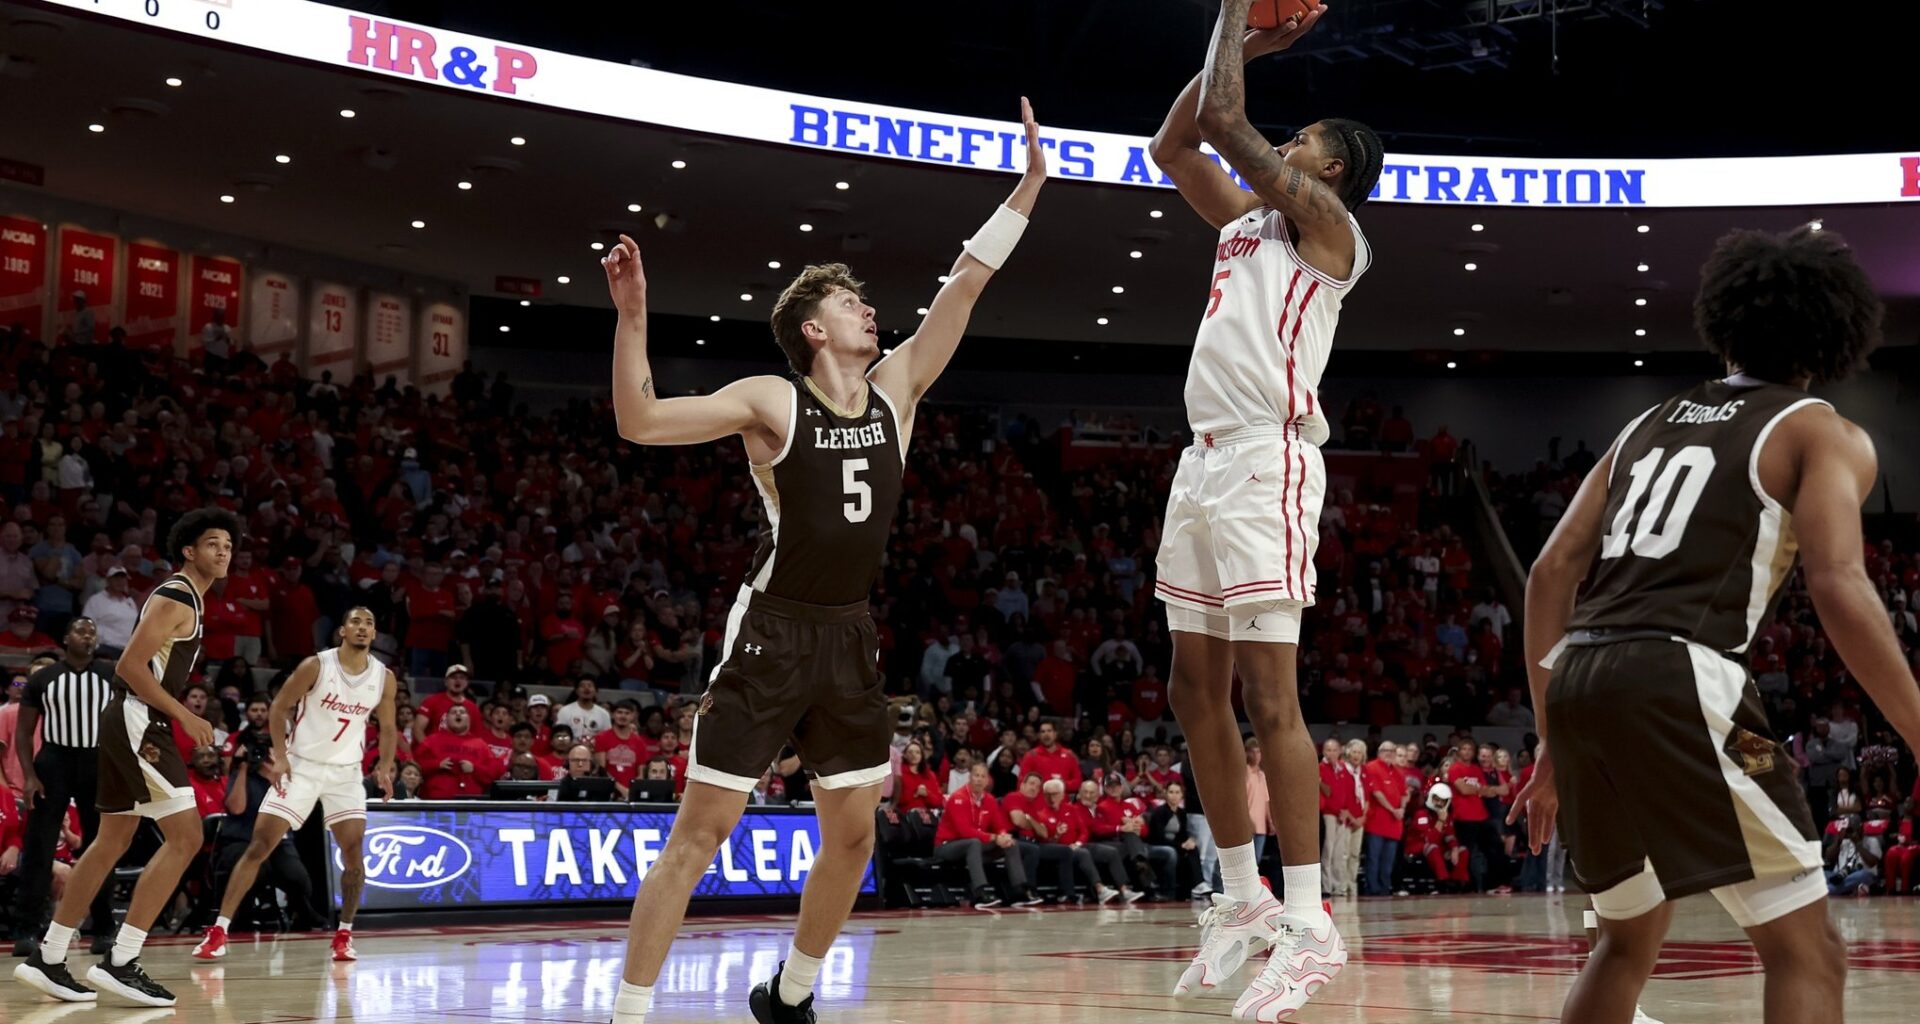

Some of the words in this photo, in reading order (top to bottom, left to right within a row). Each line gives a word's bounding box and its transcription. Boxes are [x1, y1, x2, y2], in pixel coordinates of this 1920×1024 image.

[347, 15, 537, 94] HR&P
[1120, 147, 1645, 205] ATRATION
[1, 227, 36, 246] NCAA
[70, 242, 105, 261] NCAA
[136, 256, 170, 274] NCAA
[200, 268, 233, 285] NCAA
[139, 280, 164, 299] 2021
[325, 309, 341, 332] 13
[432, 332, 450, 357] 31
[814, 421, 887, 449] LEHIGH
[842, 457, 872, 523] 5
[1601, 446, 1717, 560] 10
[320, 692, 371, 716] Houston
[331, 717, 351, 742] 7
